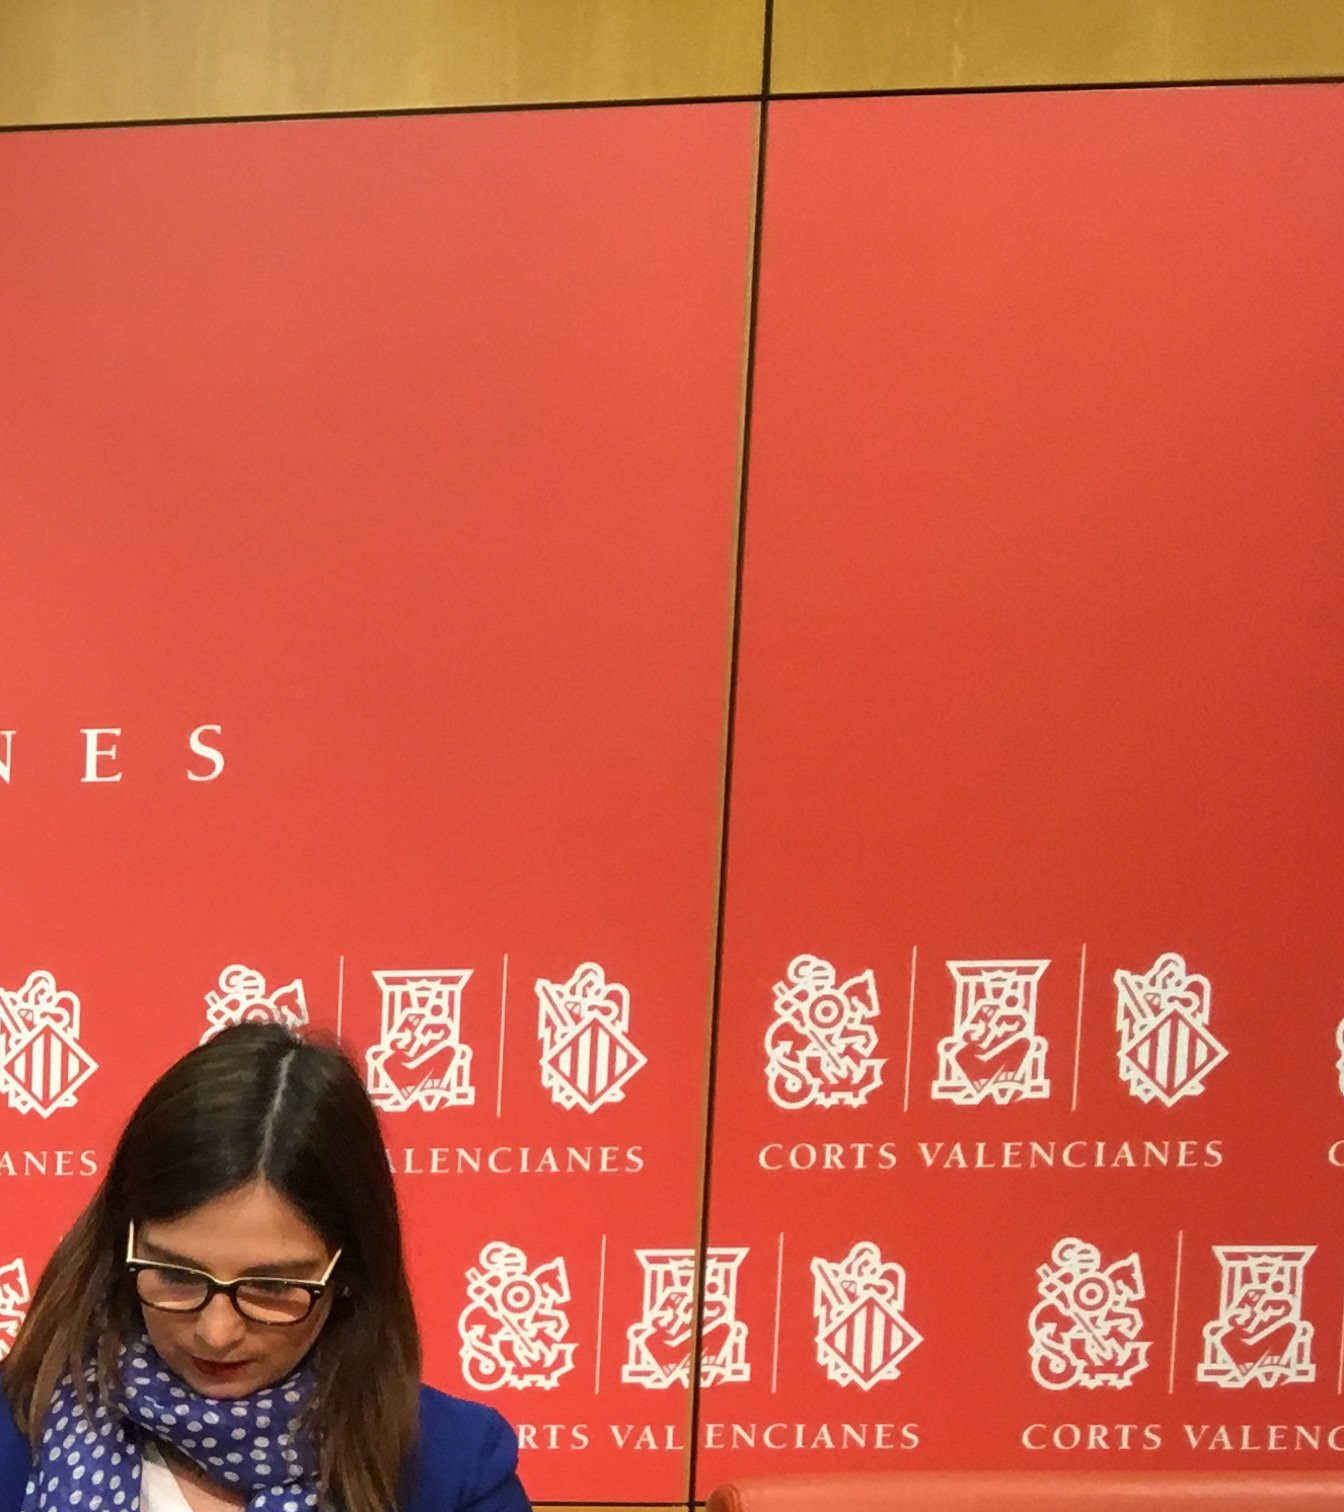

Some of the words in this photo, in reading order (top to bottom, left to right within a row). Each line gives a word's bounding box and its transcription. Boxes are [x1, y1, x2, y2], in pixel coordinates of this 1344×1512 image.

[385, 1145, 644, 1174] LENCIANES
[758, 1142, 897, 1170] CORTS
[918, 1140, 1223, 1169] VALENCIANES
[516, 1423, 589, 1450] RTS
[610, 1423, 920, 1450] VALENCIANES
[1021, 1423, 1162, 1450] CORTS
[1183, 1424, 1344, 1452] VALENC
